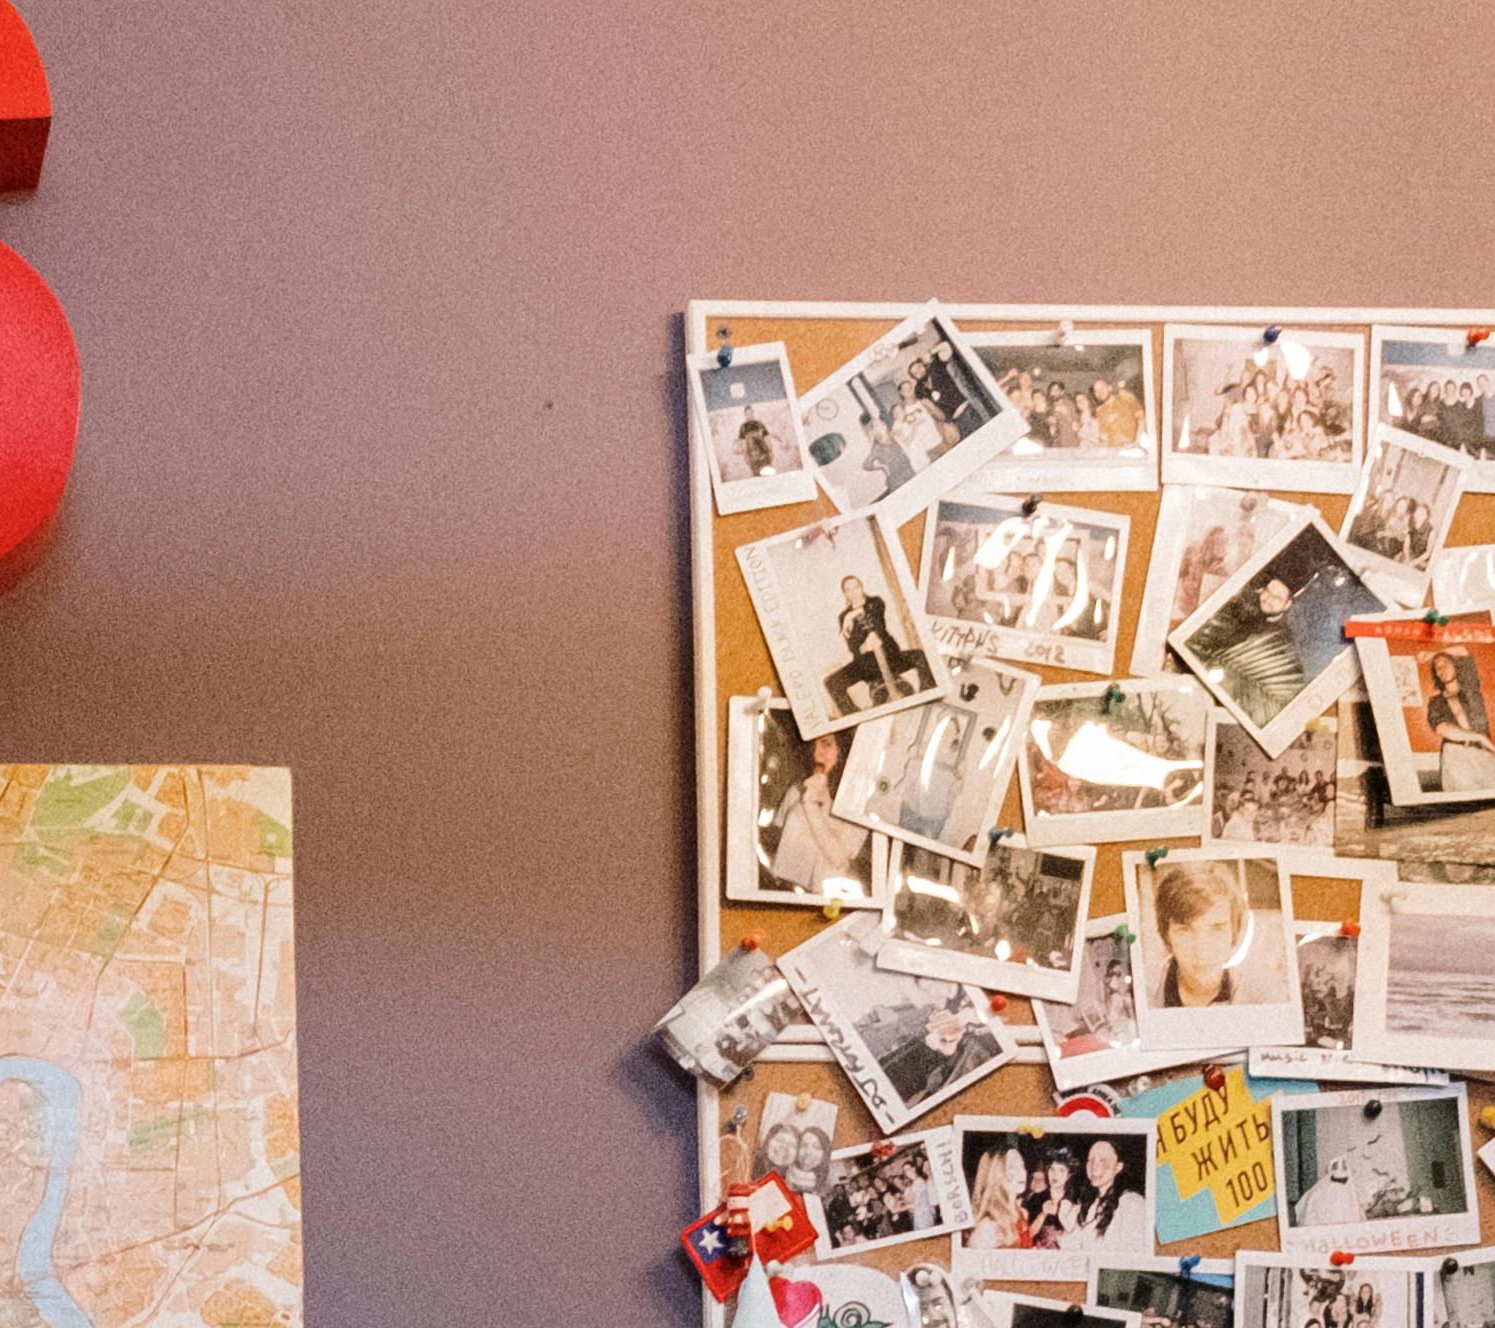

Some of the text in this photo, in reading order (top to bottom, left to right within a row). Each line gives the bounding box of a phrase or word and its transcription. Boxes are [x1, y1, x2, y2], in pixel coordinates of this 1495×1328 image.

[1170, 1086, 1230, 1144] БУДУ
[1191, 1113, 1270, 1181] ЖИТЬ
[1226, 1162, 1269, 1207] 100
